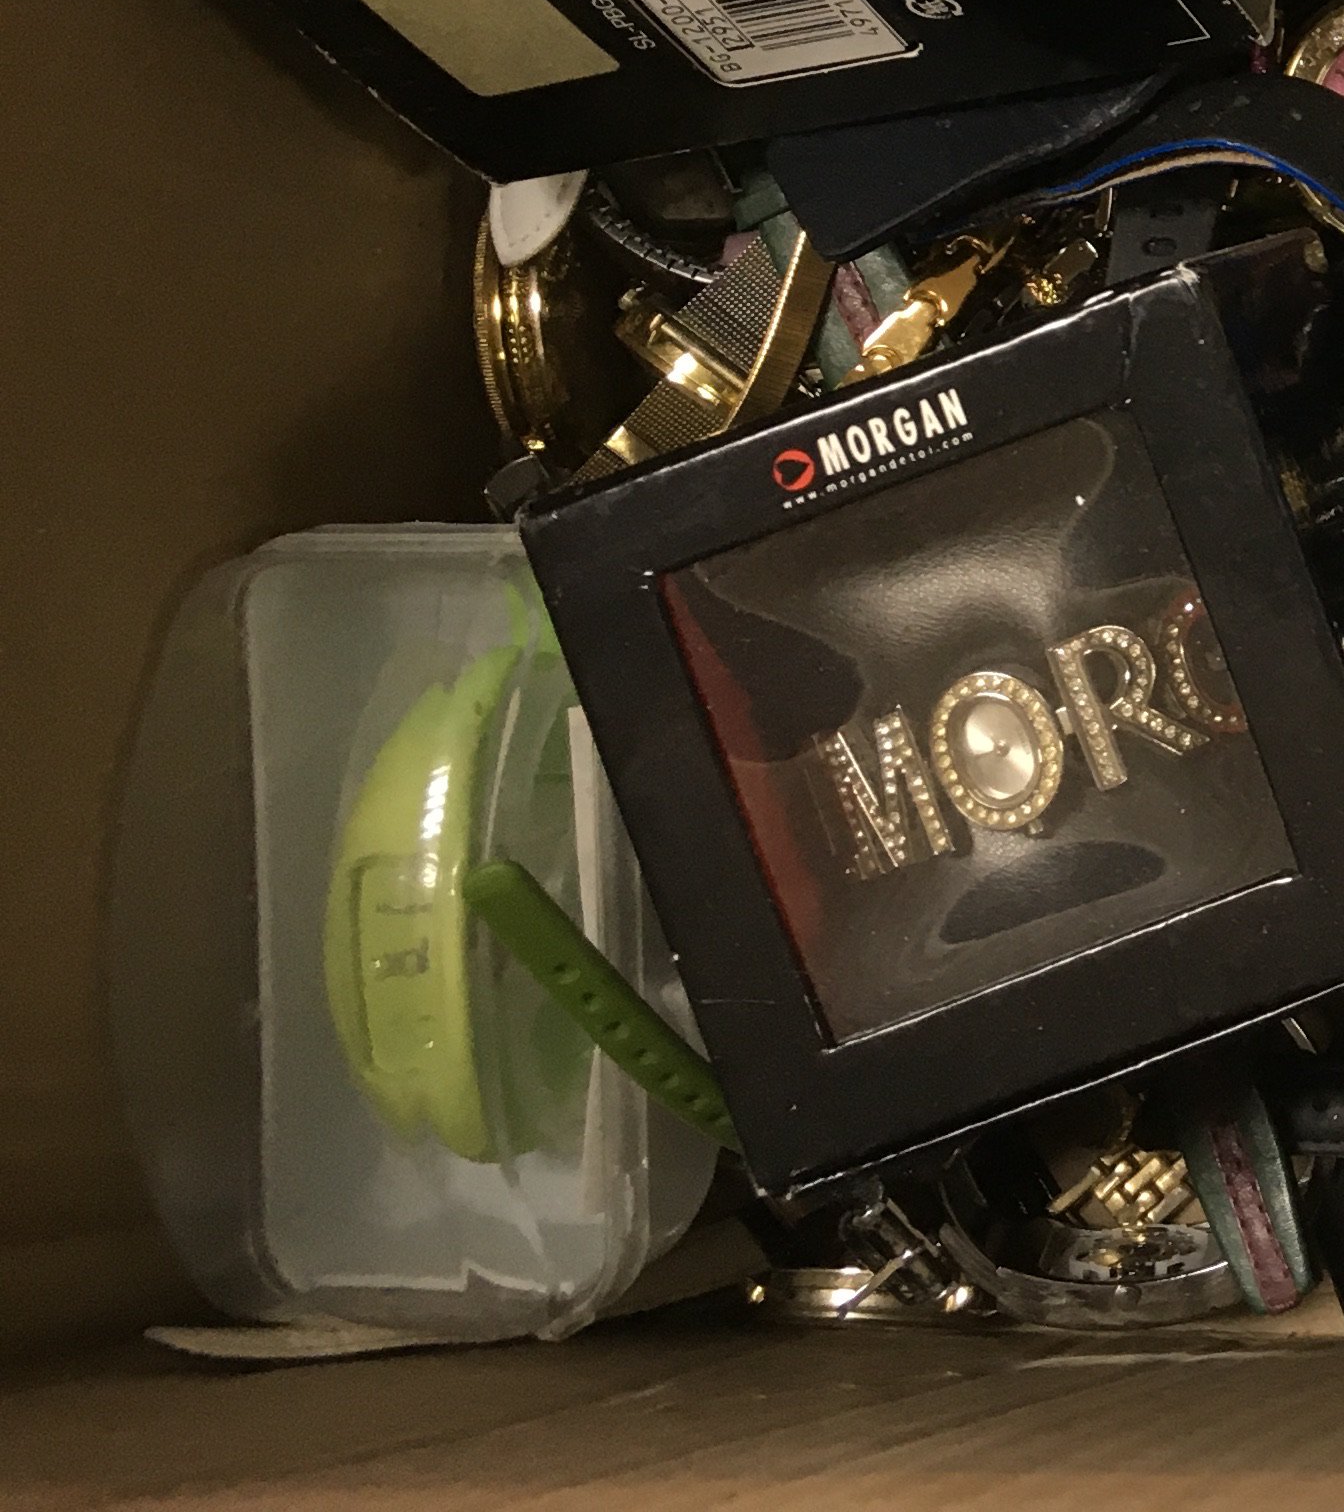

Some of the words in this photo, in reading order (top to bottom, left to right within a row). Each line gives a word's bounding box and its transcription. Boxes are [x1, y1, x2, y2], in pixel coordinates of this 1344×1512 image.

[700, 5, 745, 49] 2951
[782, 431, 974, 510] www.morgandetoi.com
[816, 387, 969, 476] MORGAN
